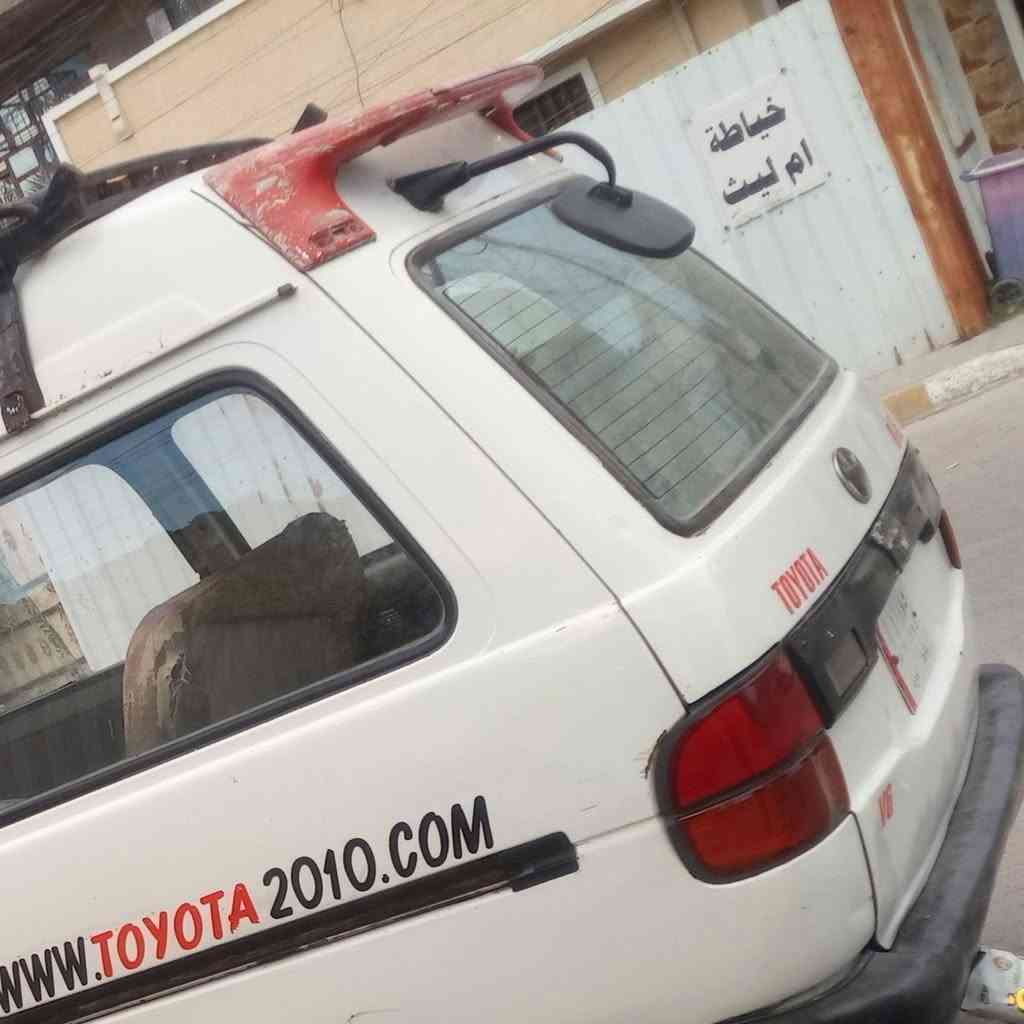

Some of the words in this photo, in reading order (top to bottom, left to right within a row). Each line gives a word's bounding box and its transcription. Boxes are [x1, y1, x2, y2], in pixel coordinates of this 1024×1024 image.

[705, 97, 786, 152] خياطة
[722, 156, 780, 205] ليث
[785, 138, 814, 185] ام
[771, 547, 828, 615] TOYOTA
